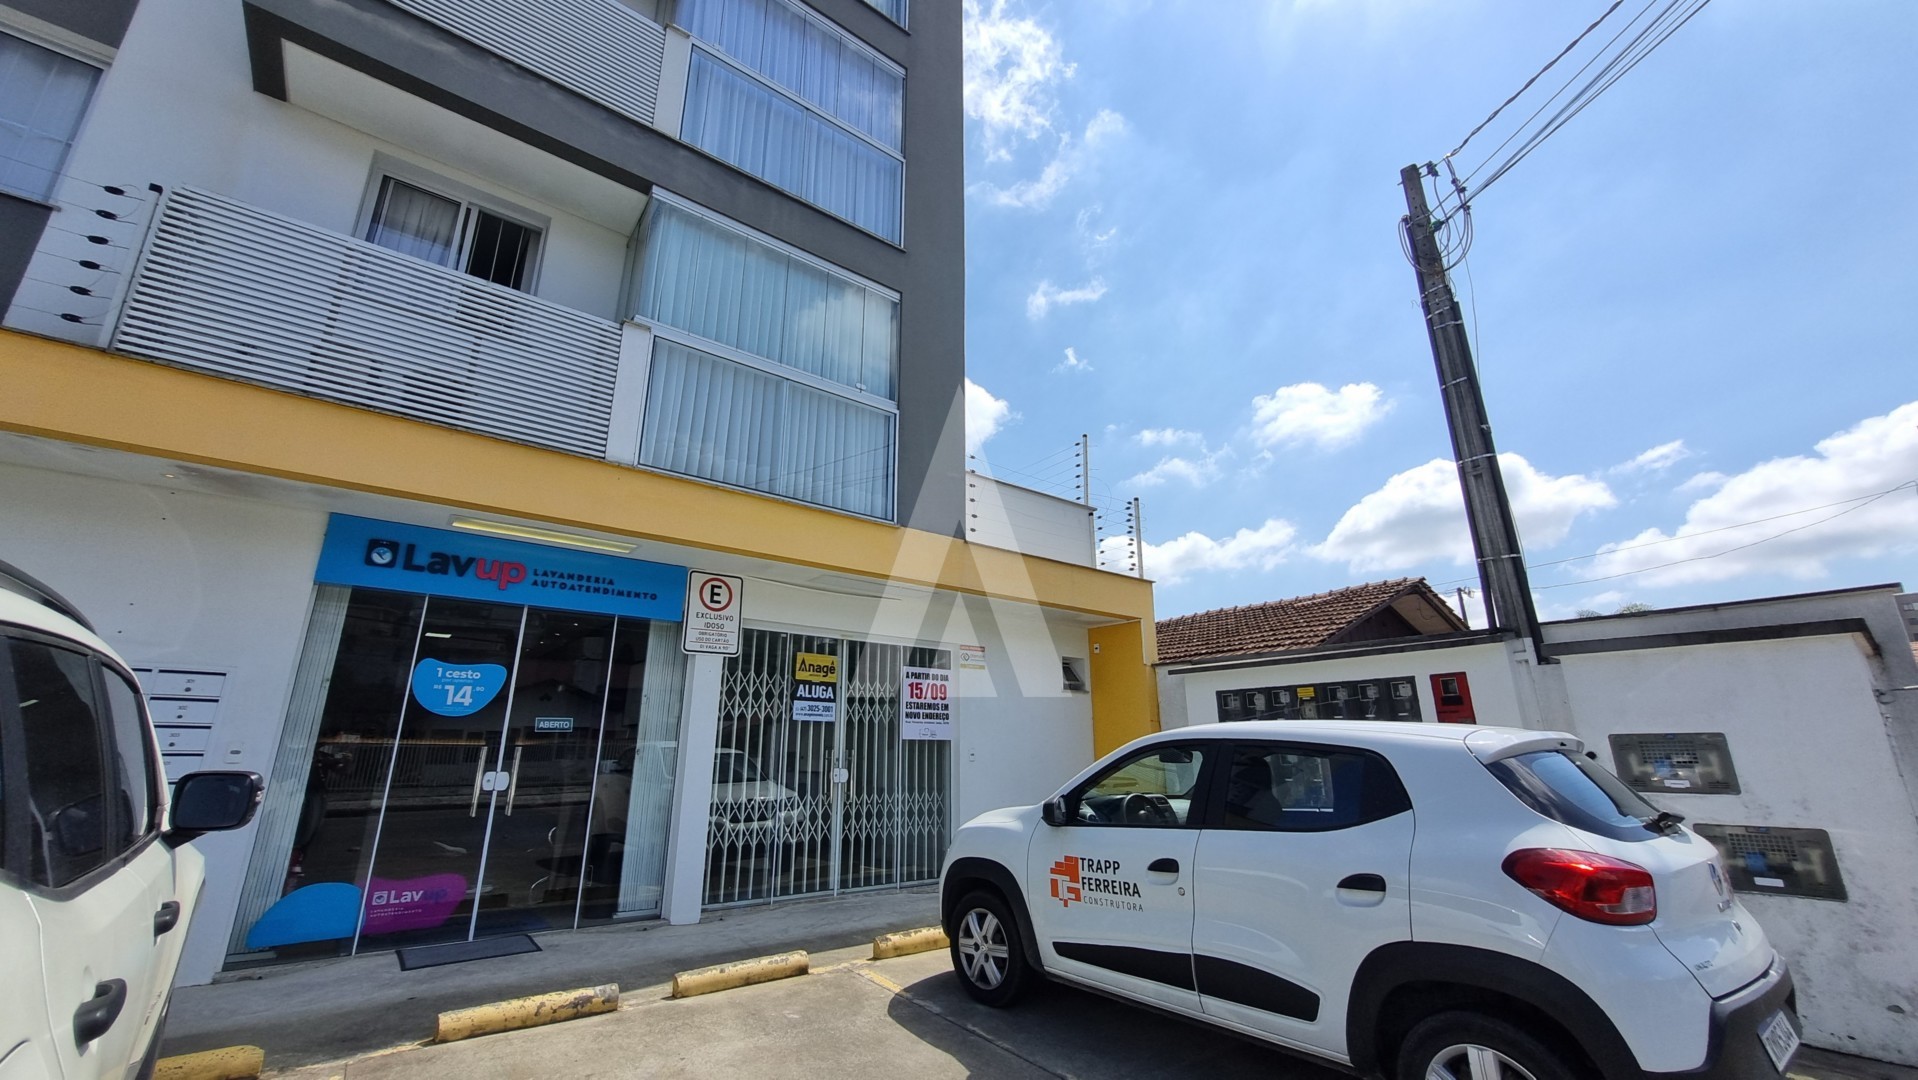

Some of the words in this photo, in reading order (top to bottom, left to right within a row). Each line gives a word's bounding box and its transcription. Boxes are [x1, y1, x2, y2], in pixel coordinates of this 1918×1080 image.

[403, 543, 527, 590] Lavup
[533, 568, 615, 586] LAVANDERIA
[531, 579, 658, 601] AUTOATENDIMENTO
[710, 584, 722, 604] E
[696, 612, 734, 622] EXCLUSIVO
[437, 667, 443, 678] 1
[446, 670, 481, 679] cesto
[798, 657, 836, 677] Anagê
[911, 672, 930, 680] PARTIR
[796, 684, 834, 699] ALUGA
[908, 682, 947, 701] 15/09
[905, 702, 940, 711] ESTAREMOS
[941, 703, 949, 711] EM
[538, 721, 570, 729] ABERTO
[905, 711, 921, 719] NOVO
[922, 712, 950, 722] ENDEREÇO
[1079, 857, 1121, 875] TRAPP
[1081, 876, 1142, 898] FERREIRA
[1083, 895, 1144, 913] CONSTRUTORA
